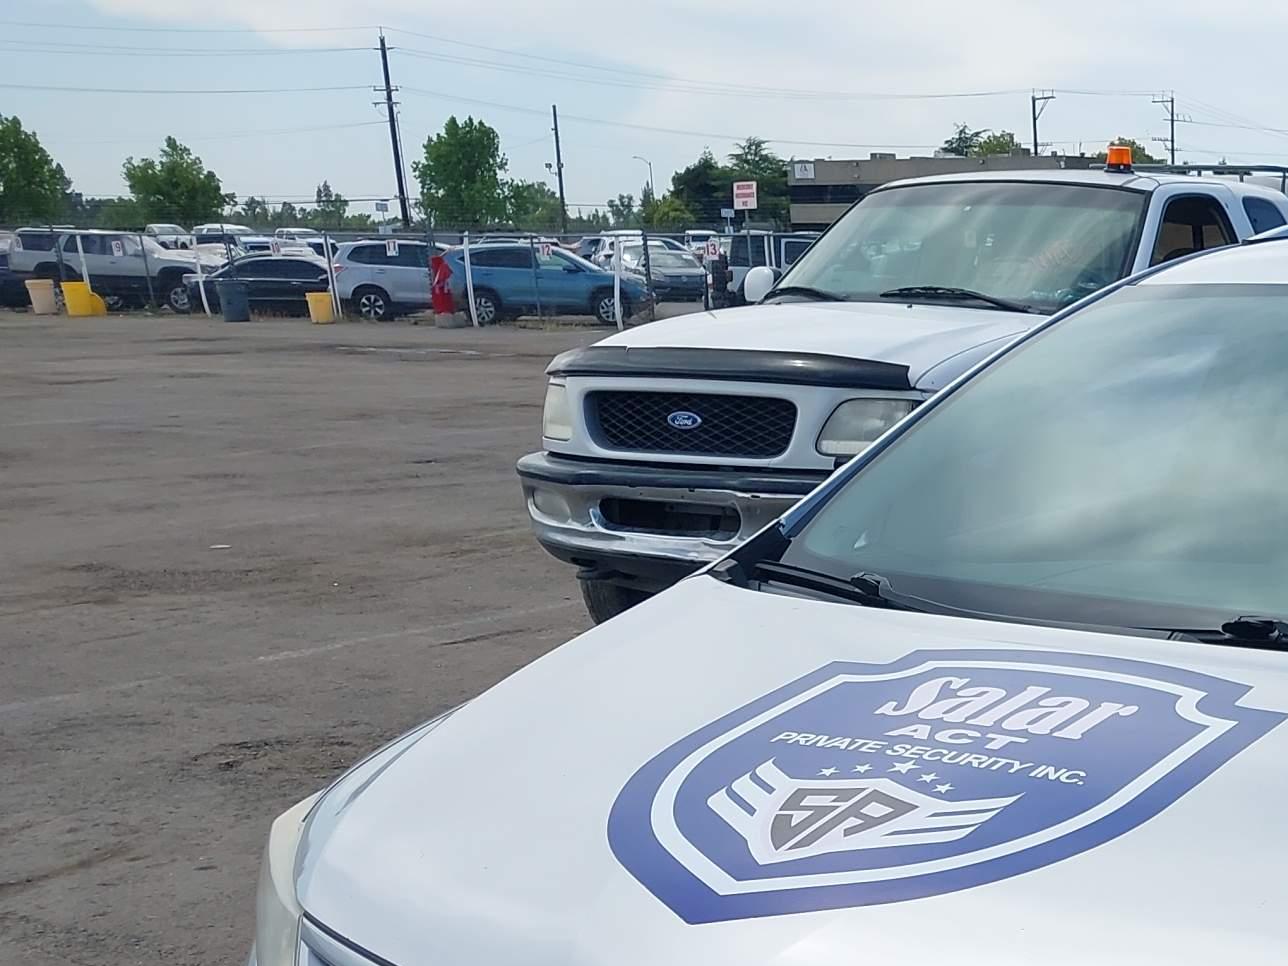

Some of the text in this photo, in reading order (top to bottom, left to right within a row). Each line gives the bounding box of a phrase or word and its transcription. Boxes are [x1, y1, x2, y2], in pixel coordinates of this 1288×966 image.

[706, 243, 717, 256] 13
[674, 414, 693, 426] Ford
[873, 676, 1139, 740] Salar
[883, 724, 1029, 750] ACT
[770, 731, 1087, 785] PRIVATE SECURITY INC.
